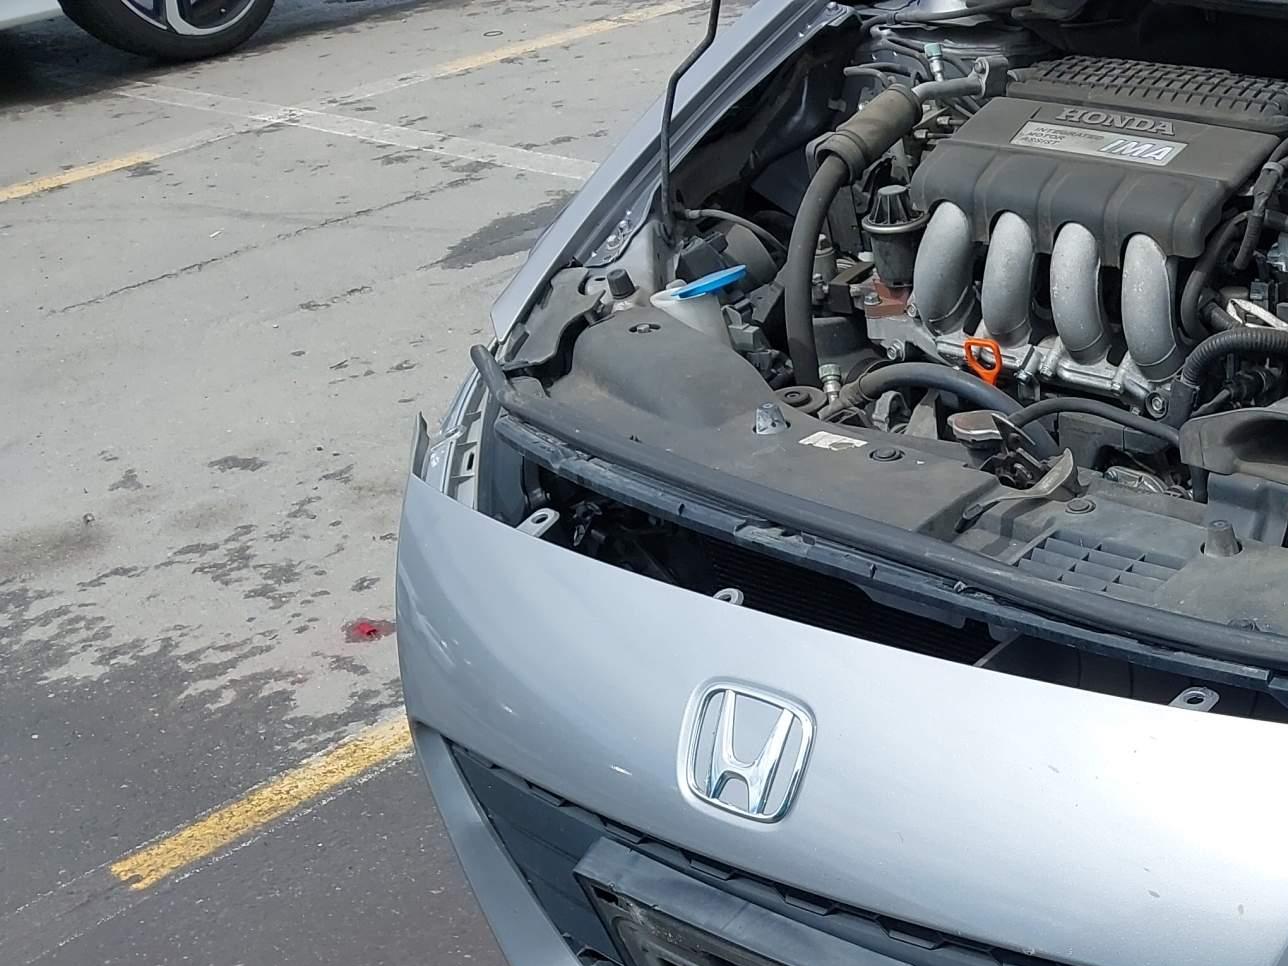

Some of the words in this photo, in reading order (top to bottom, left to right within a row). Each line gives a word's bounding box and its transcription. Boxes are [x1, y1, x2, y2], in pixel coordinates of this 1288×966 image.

[1055, 107, 1176, 137] HONDA
[1026, 131, 1066, 141] MOTOR
[1099, 138, 1175, 161] IMA
